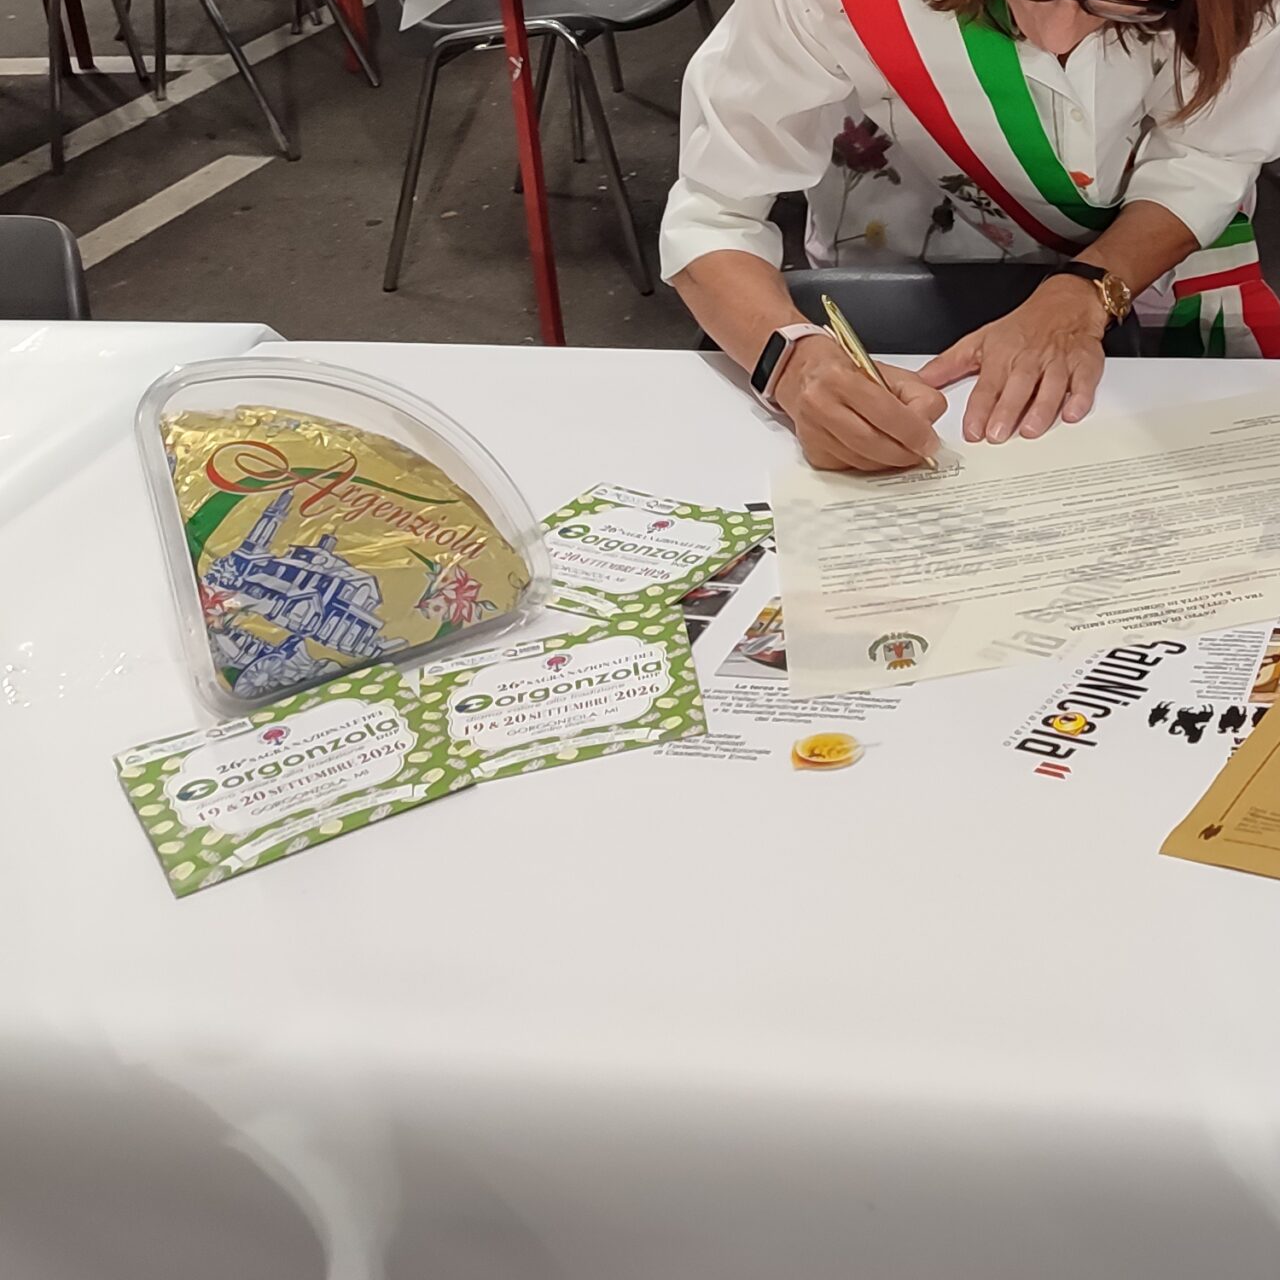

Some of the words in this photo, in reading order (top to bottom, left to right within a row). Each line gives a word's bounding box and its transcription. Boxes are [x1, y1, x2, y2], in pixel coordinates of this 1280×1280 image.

[206, 440, 489, 560] Argenziola
[635, 567, 671, 580] 2026
[455, 660, 663, 714] Gorgonzola
[464, 723, 486, 736] 19
[488, 720, 500, 731] &
[503, 712, 527, 726] 20
[613, 684, 661, 702] 2026
[1003, 681, 1073, 748] Volontariato
[176, 718, 400, 802] Gorgonzola
[198, 807, 221, 822] 19
[240, 790, 268, 807] 20
[356, 739, 407, 766] 2026
